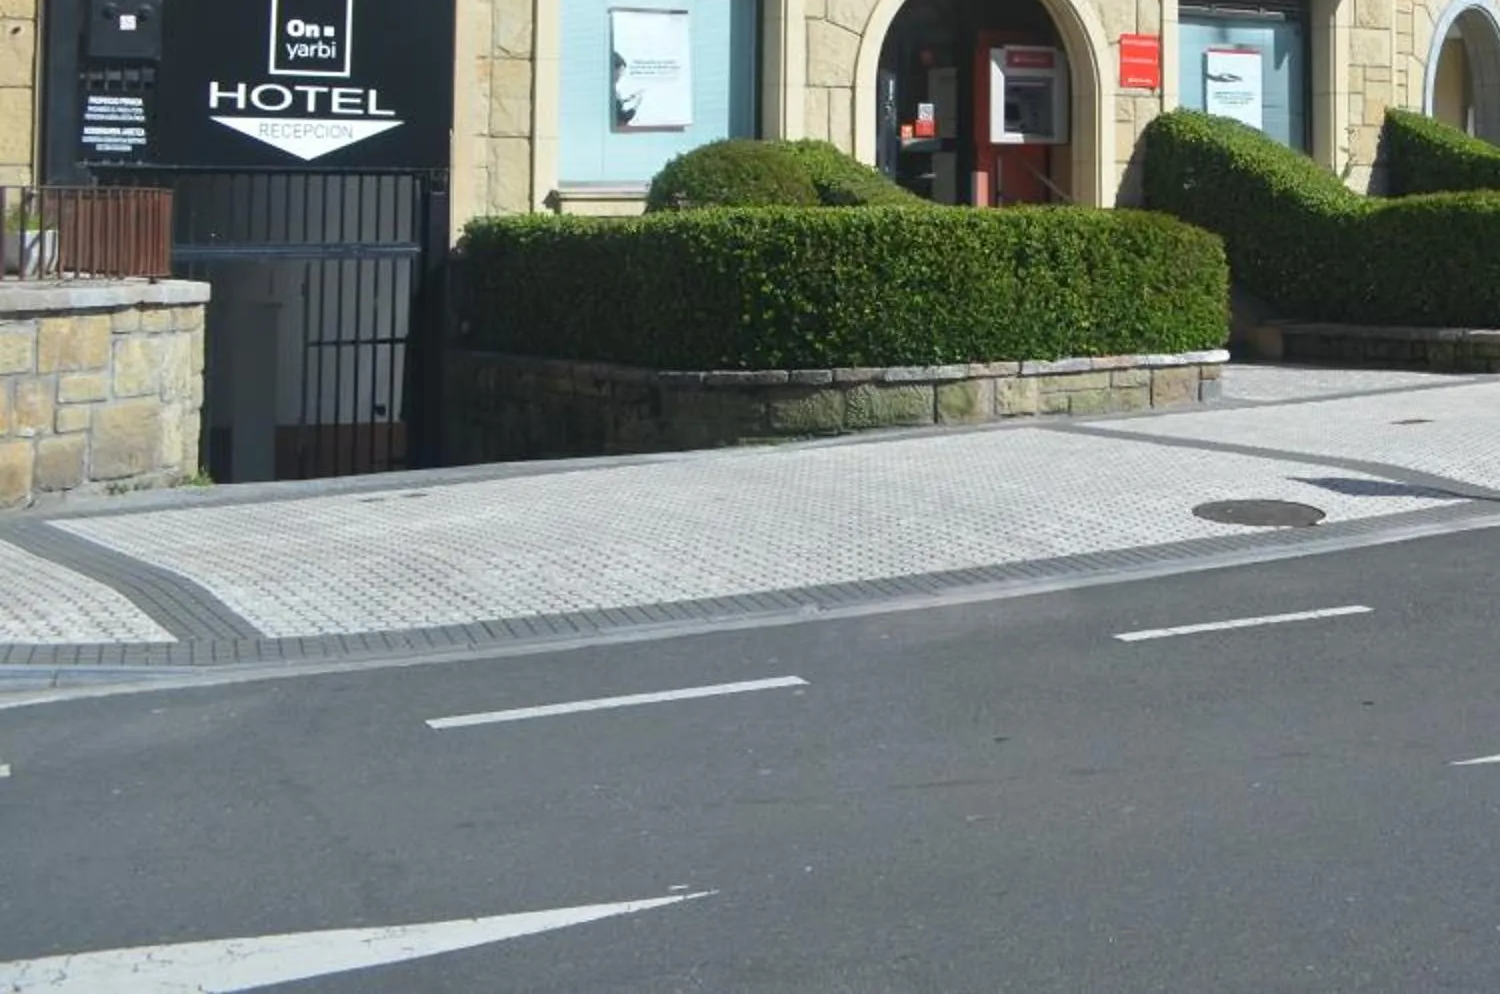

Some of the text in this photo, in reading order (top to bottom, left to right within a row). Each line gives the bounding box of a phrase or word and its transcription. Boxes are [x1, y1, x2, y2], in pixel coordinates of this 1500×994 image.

[286, 40, 337, 60] yarbi
[209, 81, 396, 116] HOTEL
[258, 122, 354, 140] RECEPCION
